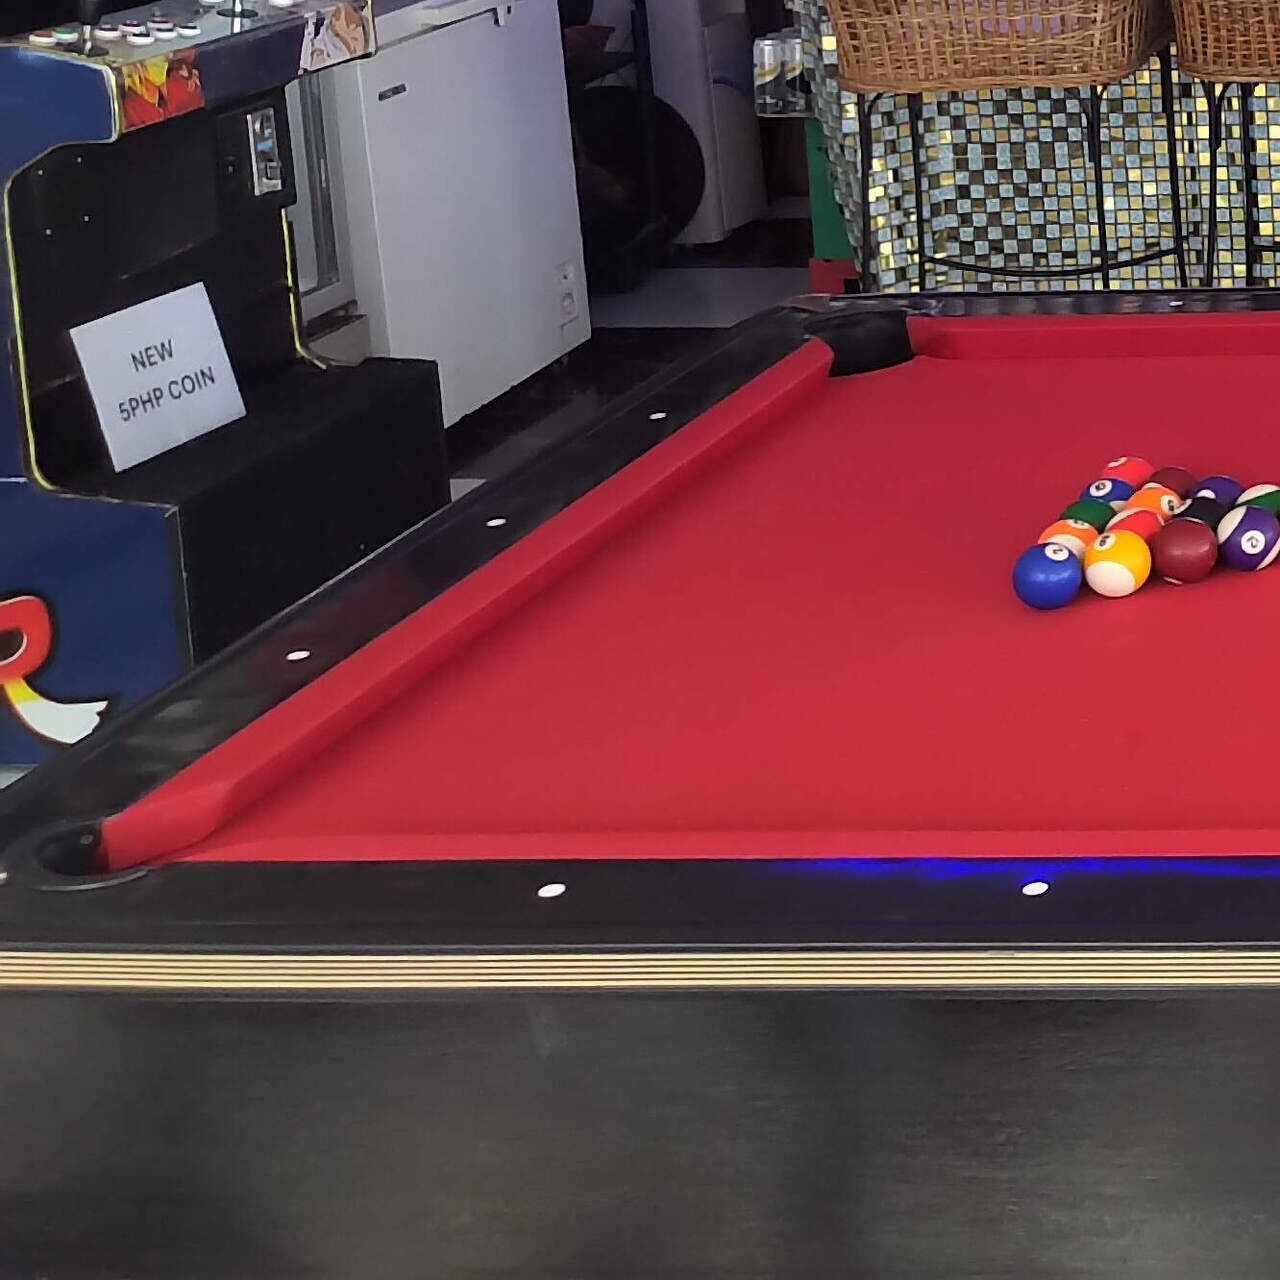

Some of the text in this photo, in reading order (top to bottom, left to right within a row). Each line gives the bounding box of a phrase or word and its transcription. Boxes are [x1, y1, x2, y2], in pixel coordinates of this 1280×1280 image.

[130, 338, 174, 372] NEW
[118, 365, 216, 422] 5PHP COIN
